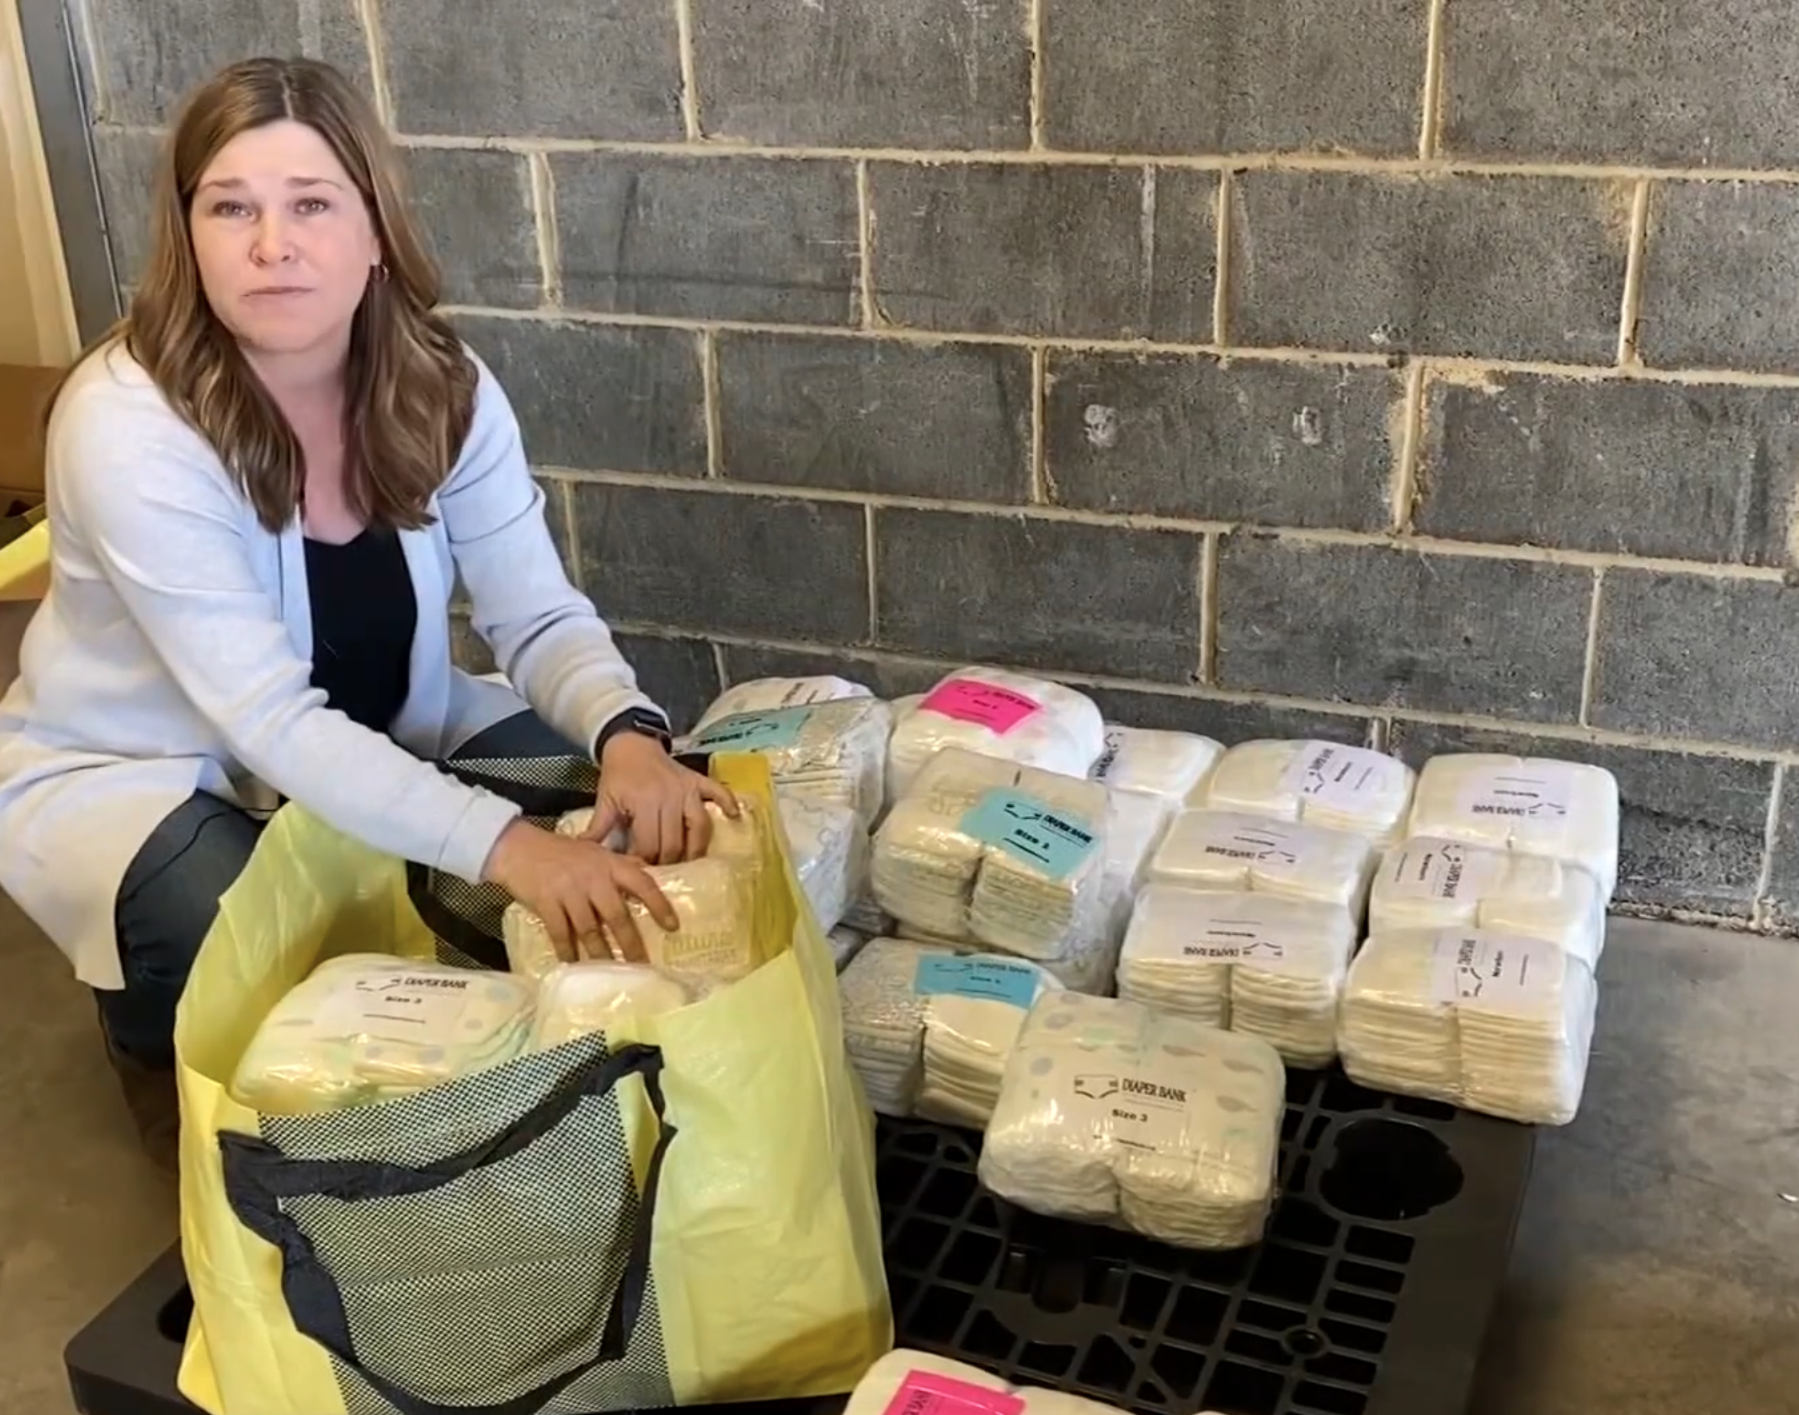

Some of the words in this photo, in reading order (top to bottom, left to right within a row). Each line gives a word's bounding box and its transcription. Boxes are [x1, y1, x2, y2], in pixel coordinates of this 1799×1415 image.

[1122, 1078, 1157, 1096] DIAPER
[1157, 1085, 1187, 1103] BANK
[1111, 1107, 1138, 1121] Size
[1139, 1113, 1148, 1122] 3
